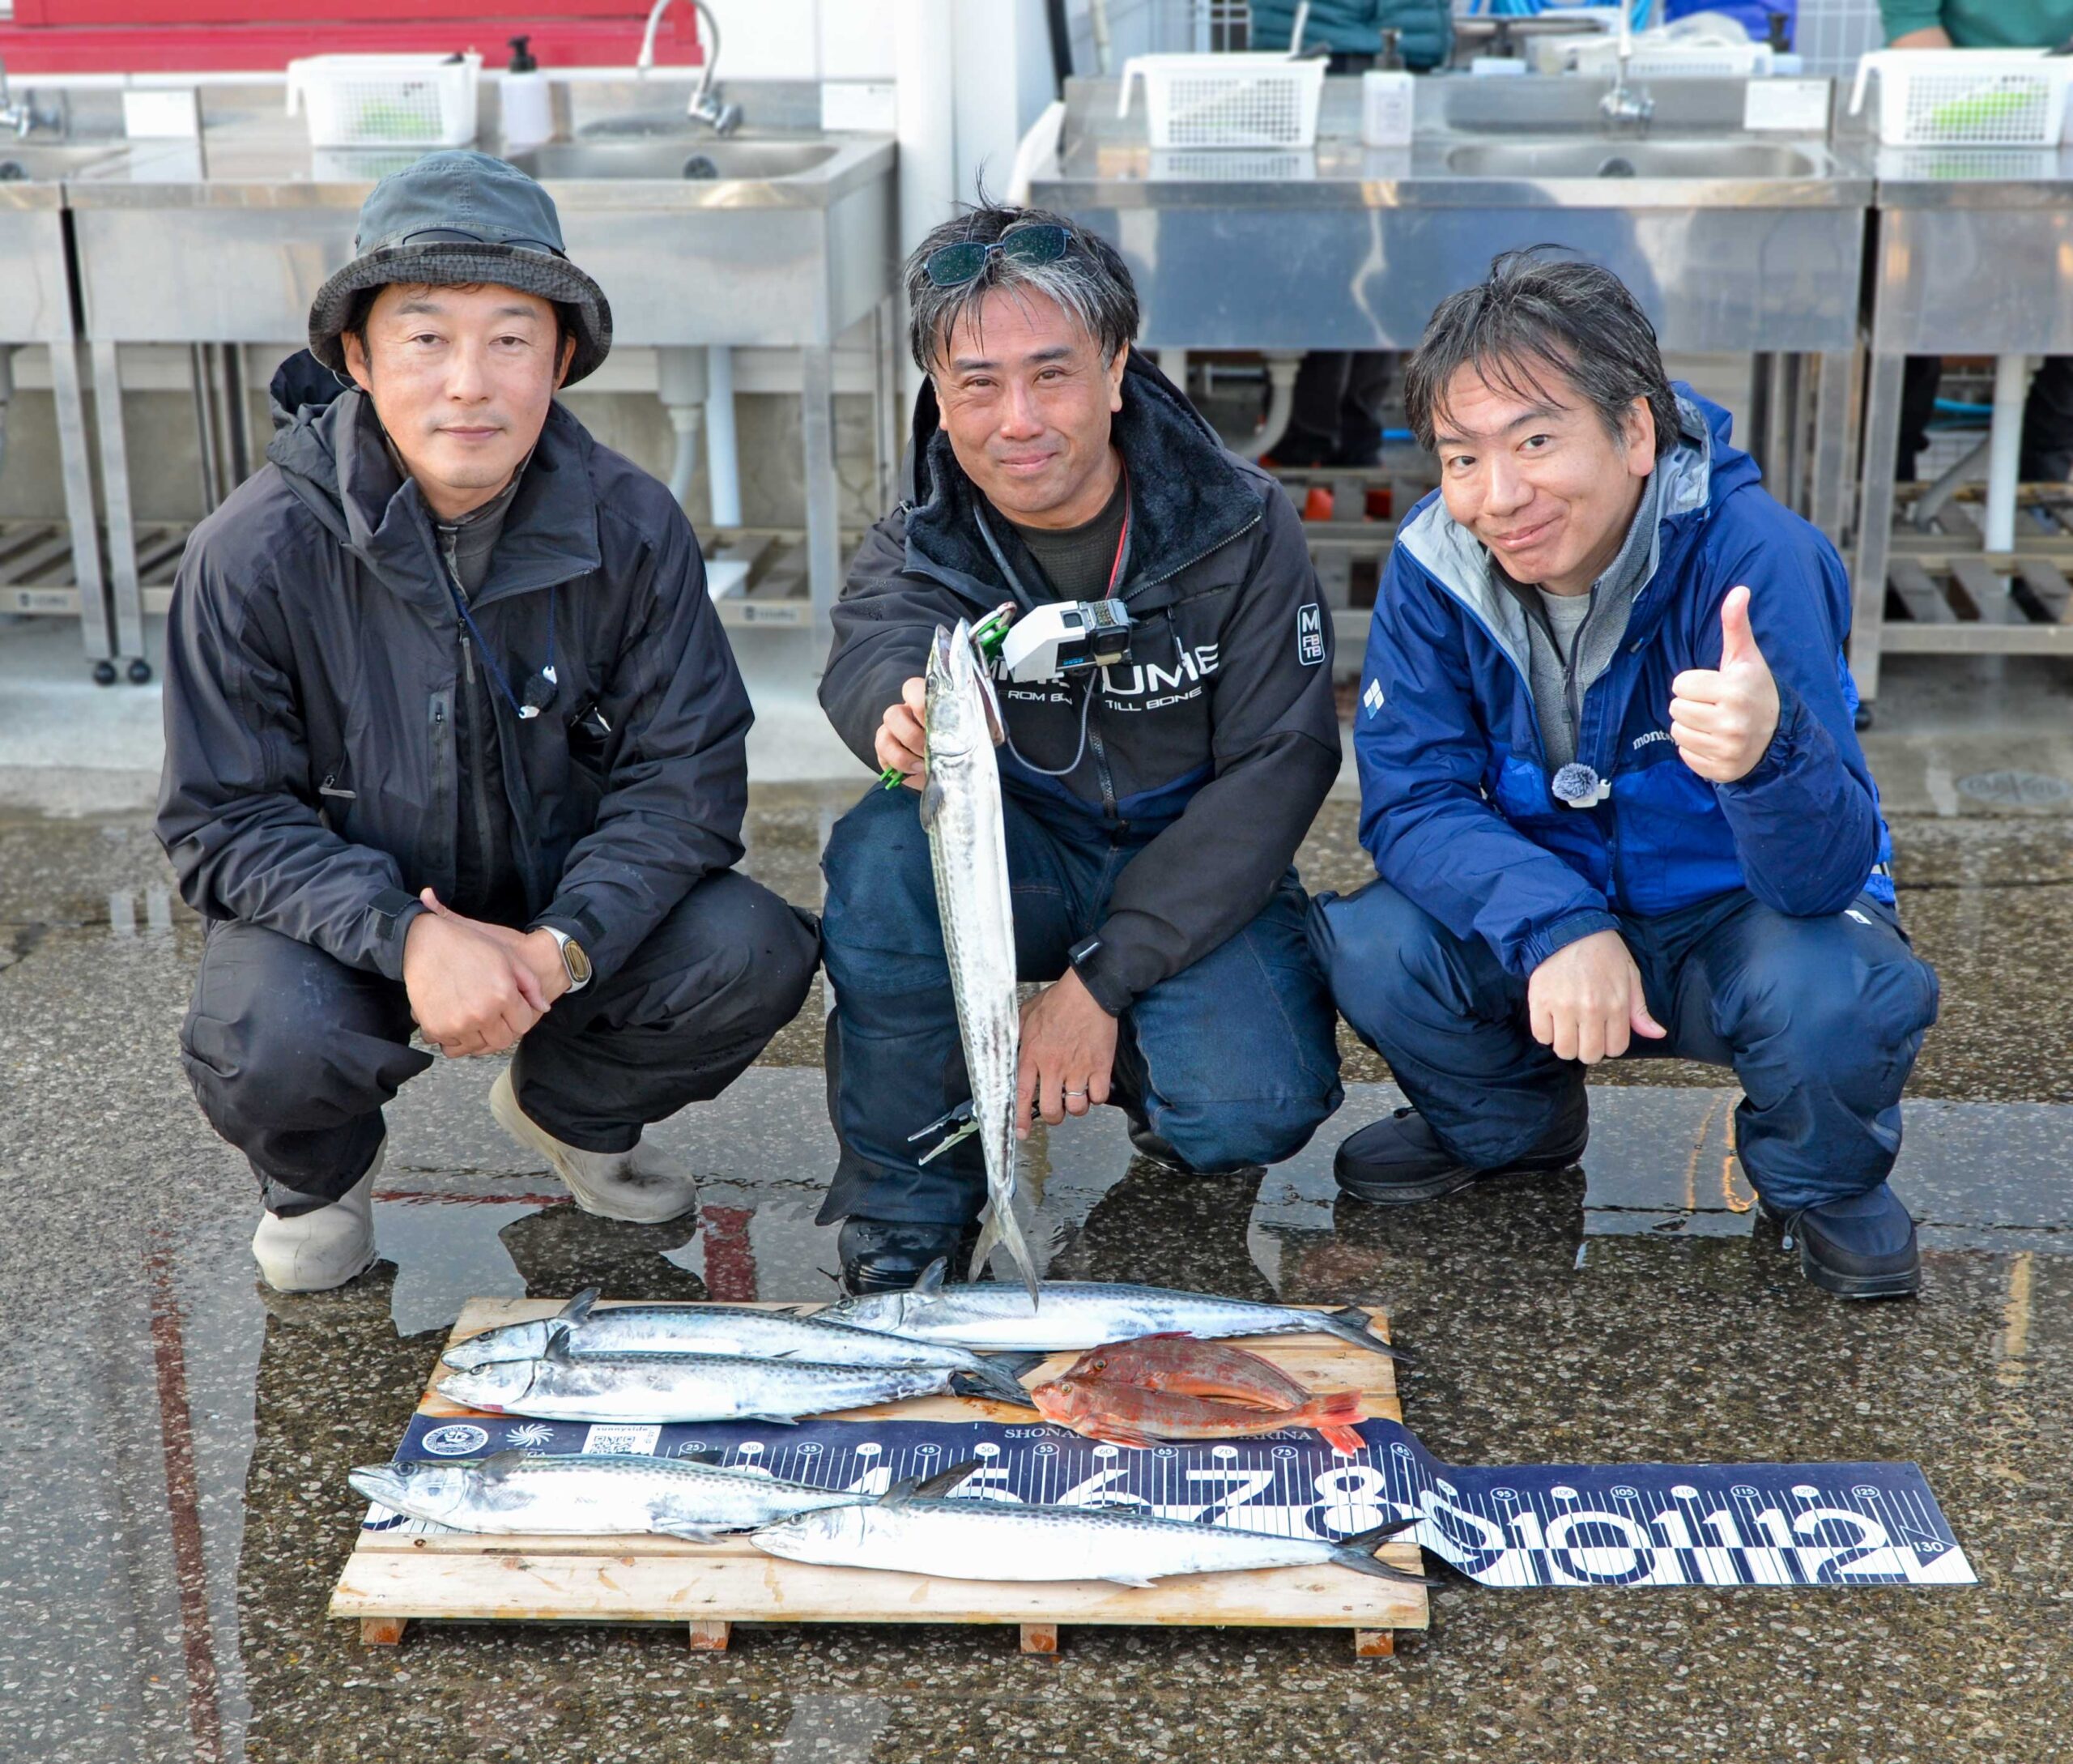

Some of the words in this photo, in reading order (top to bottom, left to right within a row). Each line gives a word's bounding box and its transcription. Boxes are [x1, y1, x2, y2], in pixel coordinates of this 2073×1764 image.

[1302, 610, 1318, 632] M
[1303, 634, 1320, 647] FB
[1303, 646, 1322, 658] TB
[1105, 700, 1142, 711] TILL
[1146, 686, 1203, 709] BONE
[1004, 1427, 1081, 1439] SHONA
[980, 1446, 994, 1454] 50
[1158, 1447, 1172, 1455] 65
[1396, 1444, 1410, 1456] 85
[1496, 1489, 1511, 1498] 95
[1614, 1488, 1633, 1496] 105
[1675, 1488, 1694, 1496] 110
[1734, 1487, 1754, 1495] 115
[1856, 1488, 1876, 1496] 125
[1912, 1541, 1944, 1553] 130
[1305, 1466, 1403, 1542] 8
